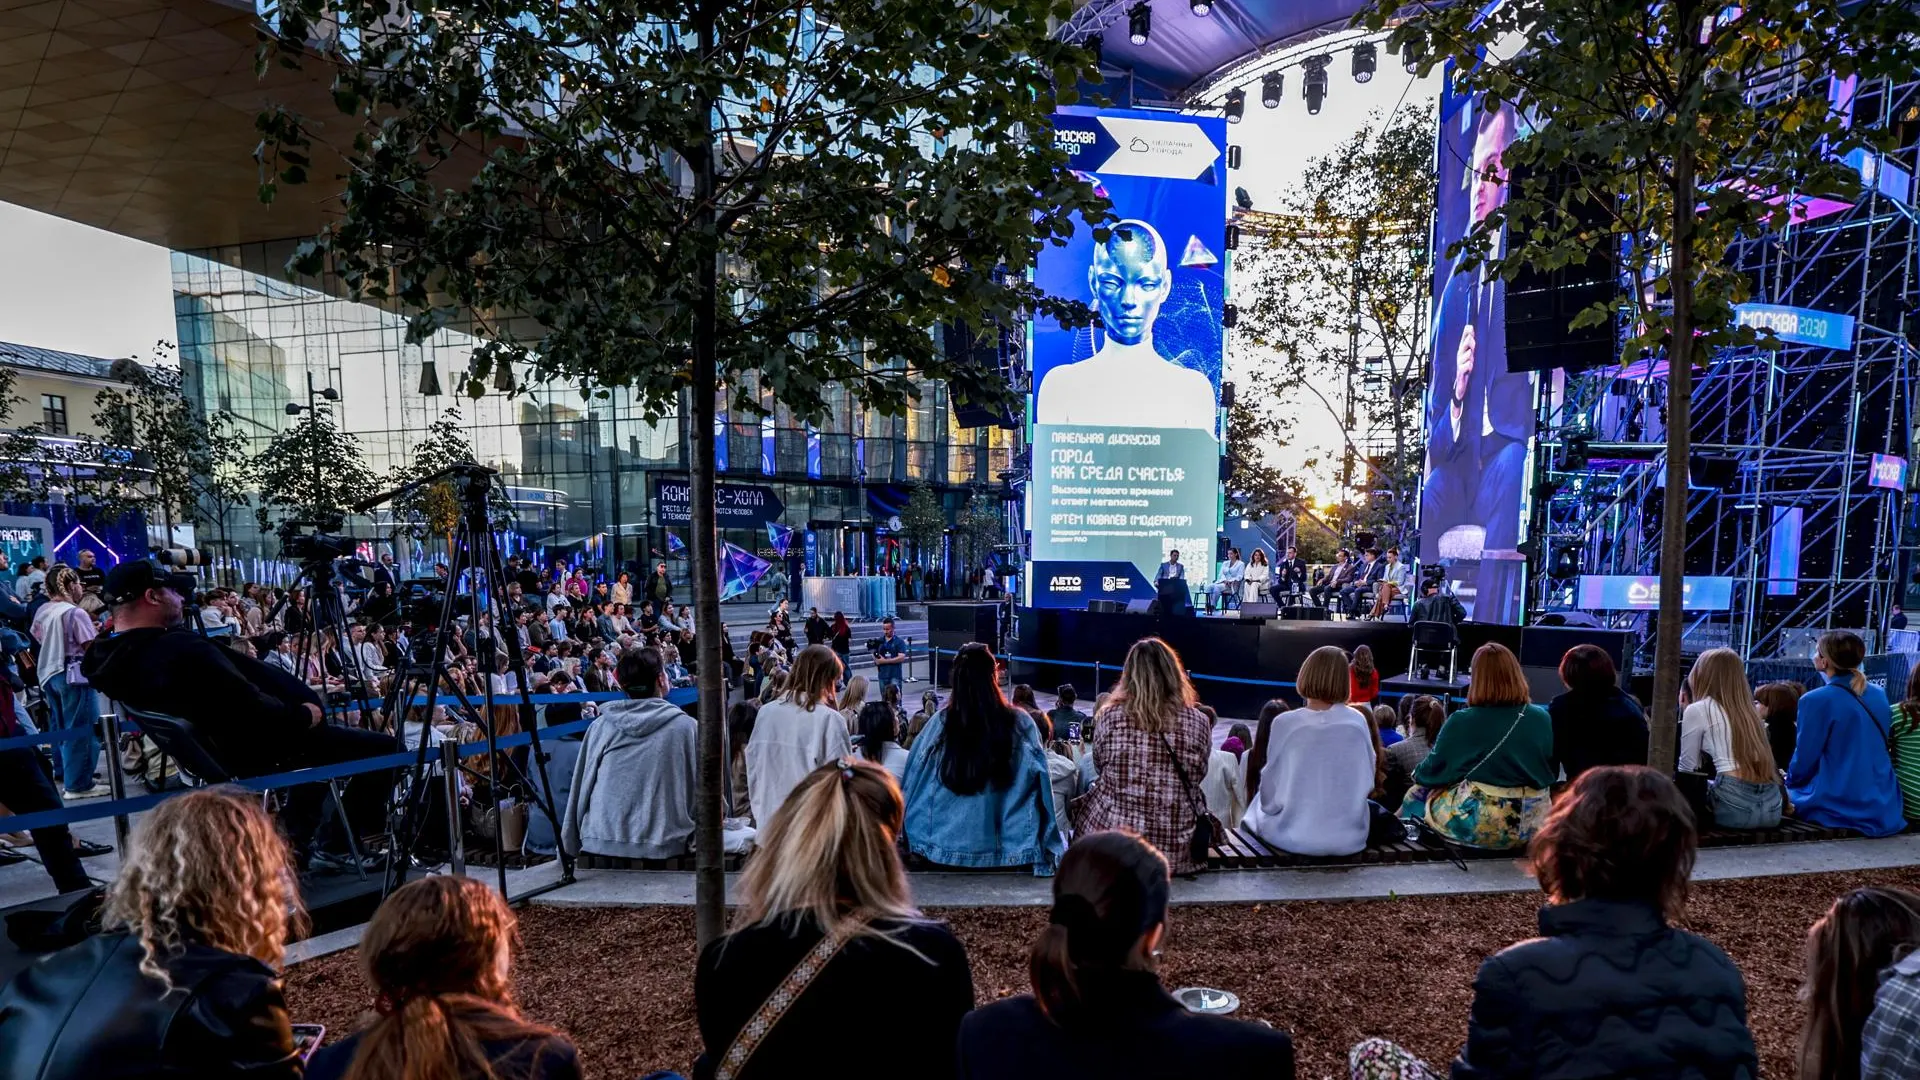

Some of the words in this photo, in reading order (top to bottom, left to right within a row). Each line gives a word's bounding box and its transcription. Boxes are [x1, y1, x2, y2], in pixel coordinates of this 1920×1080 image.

[1054, 129, 1096, 144] МОСКВА
[1740, 311, 1798, 334] МОСКВА
[1799, 317, 1828, 338] 2030
[1051, 432, 1104, 444] ПАНЕЛЬНАЯ
[1107, 433, 1161, 446] ДИСКУССИЯ
[1051, 449, 1094, 464] ГОРОД
[1051, 465, 1075, 480] КАК
[1080, 466, 1123, 481] СРЕДА
[1051, 484, 1091, 496] Вызовы
[1093, 486, 1128, 497] нового
[1130, 488, 1173, 498] времени
[1051, 499, 1058, 507] и
[1060, 498, 1088, 507] ответ
[1090, 499, 1149, 508] мегаполиса
[1130, 514, 1192, 527] (МОДЕРАТОР)
[1050, 576, 1082, 586] ЛЕТО
